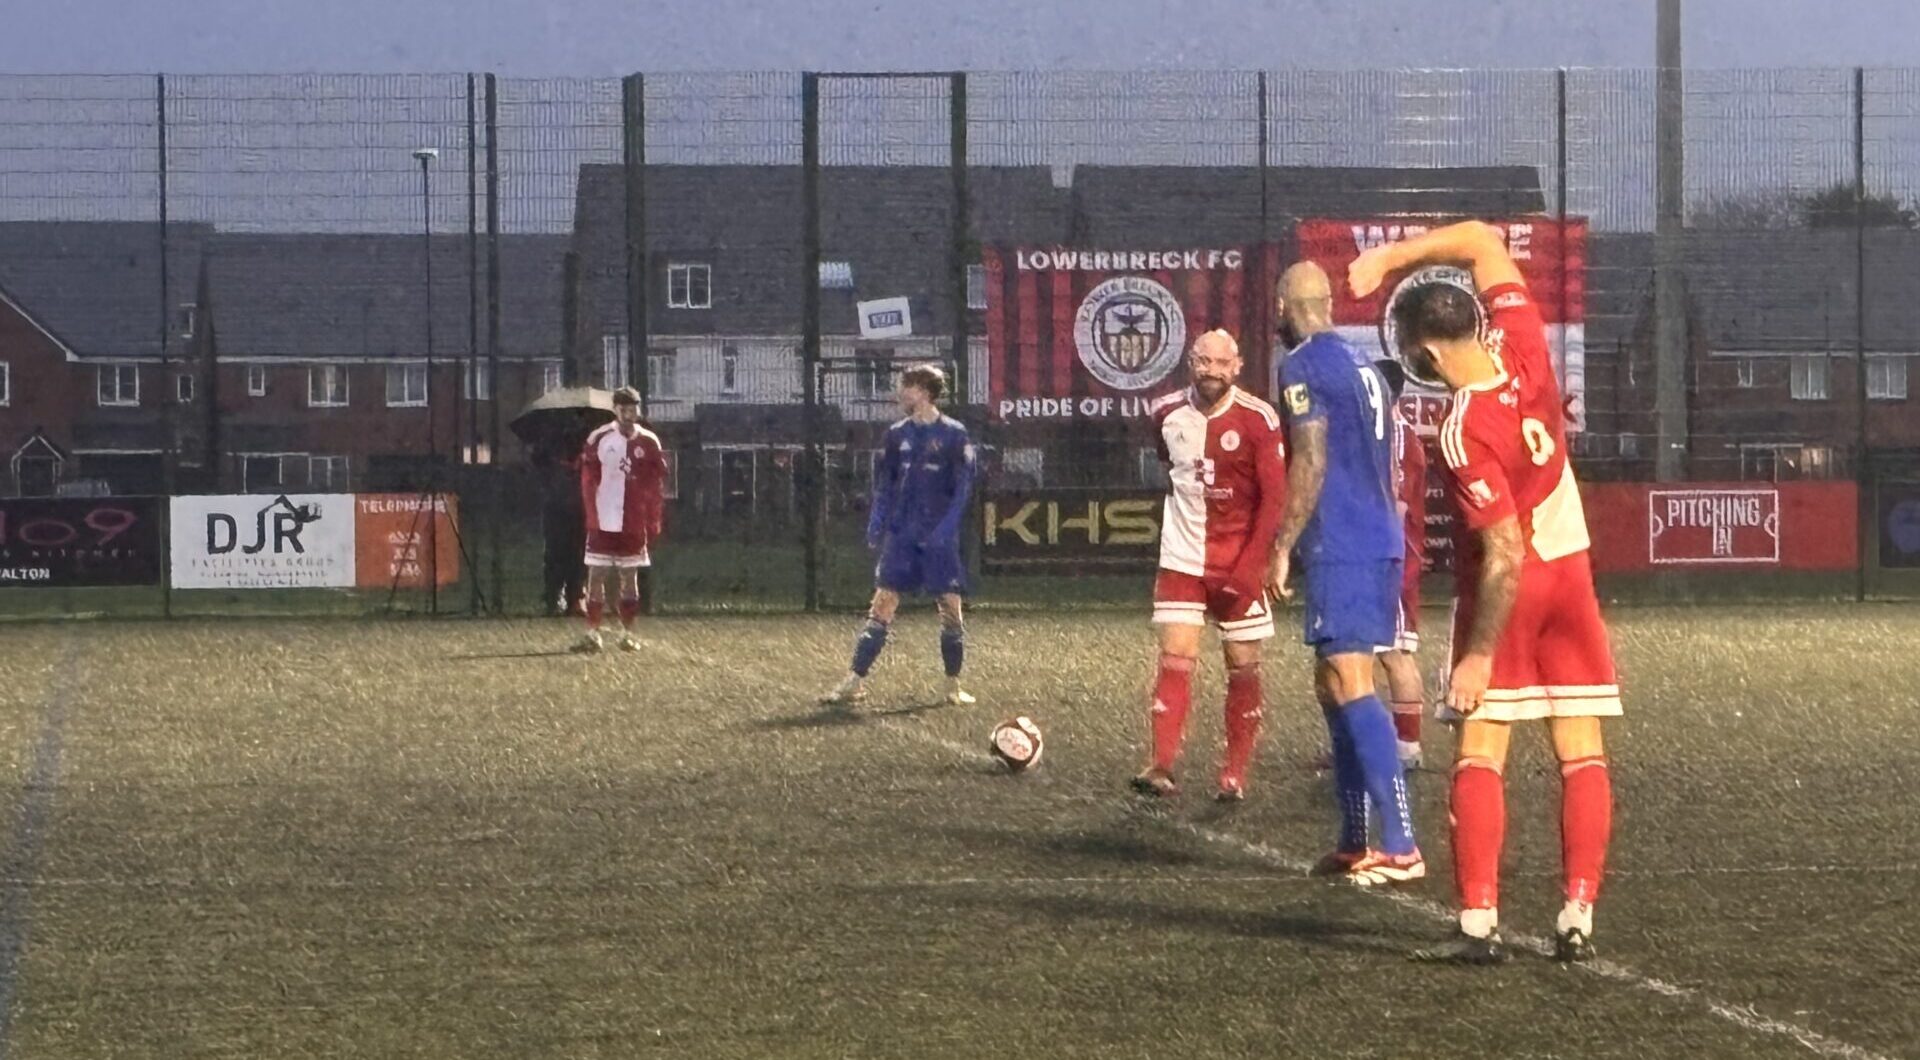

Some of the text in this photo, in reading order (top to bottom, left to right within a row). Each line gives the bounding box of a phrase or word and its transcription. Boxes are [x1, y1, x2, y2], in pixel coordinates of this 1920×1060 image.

[1016, 250, 1242, 271] LOWERBRECK FC
[999, 397, 1153, 419] PRIDE OF LIV
[1358, 367, 1384, 440] 9
[984, 500, 1160, 546] KHS
[1667, 497, 1760, 527] PITCHING
[206, 511, 305, 555] DJR
